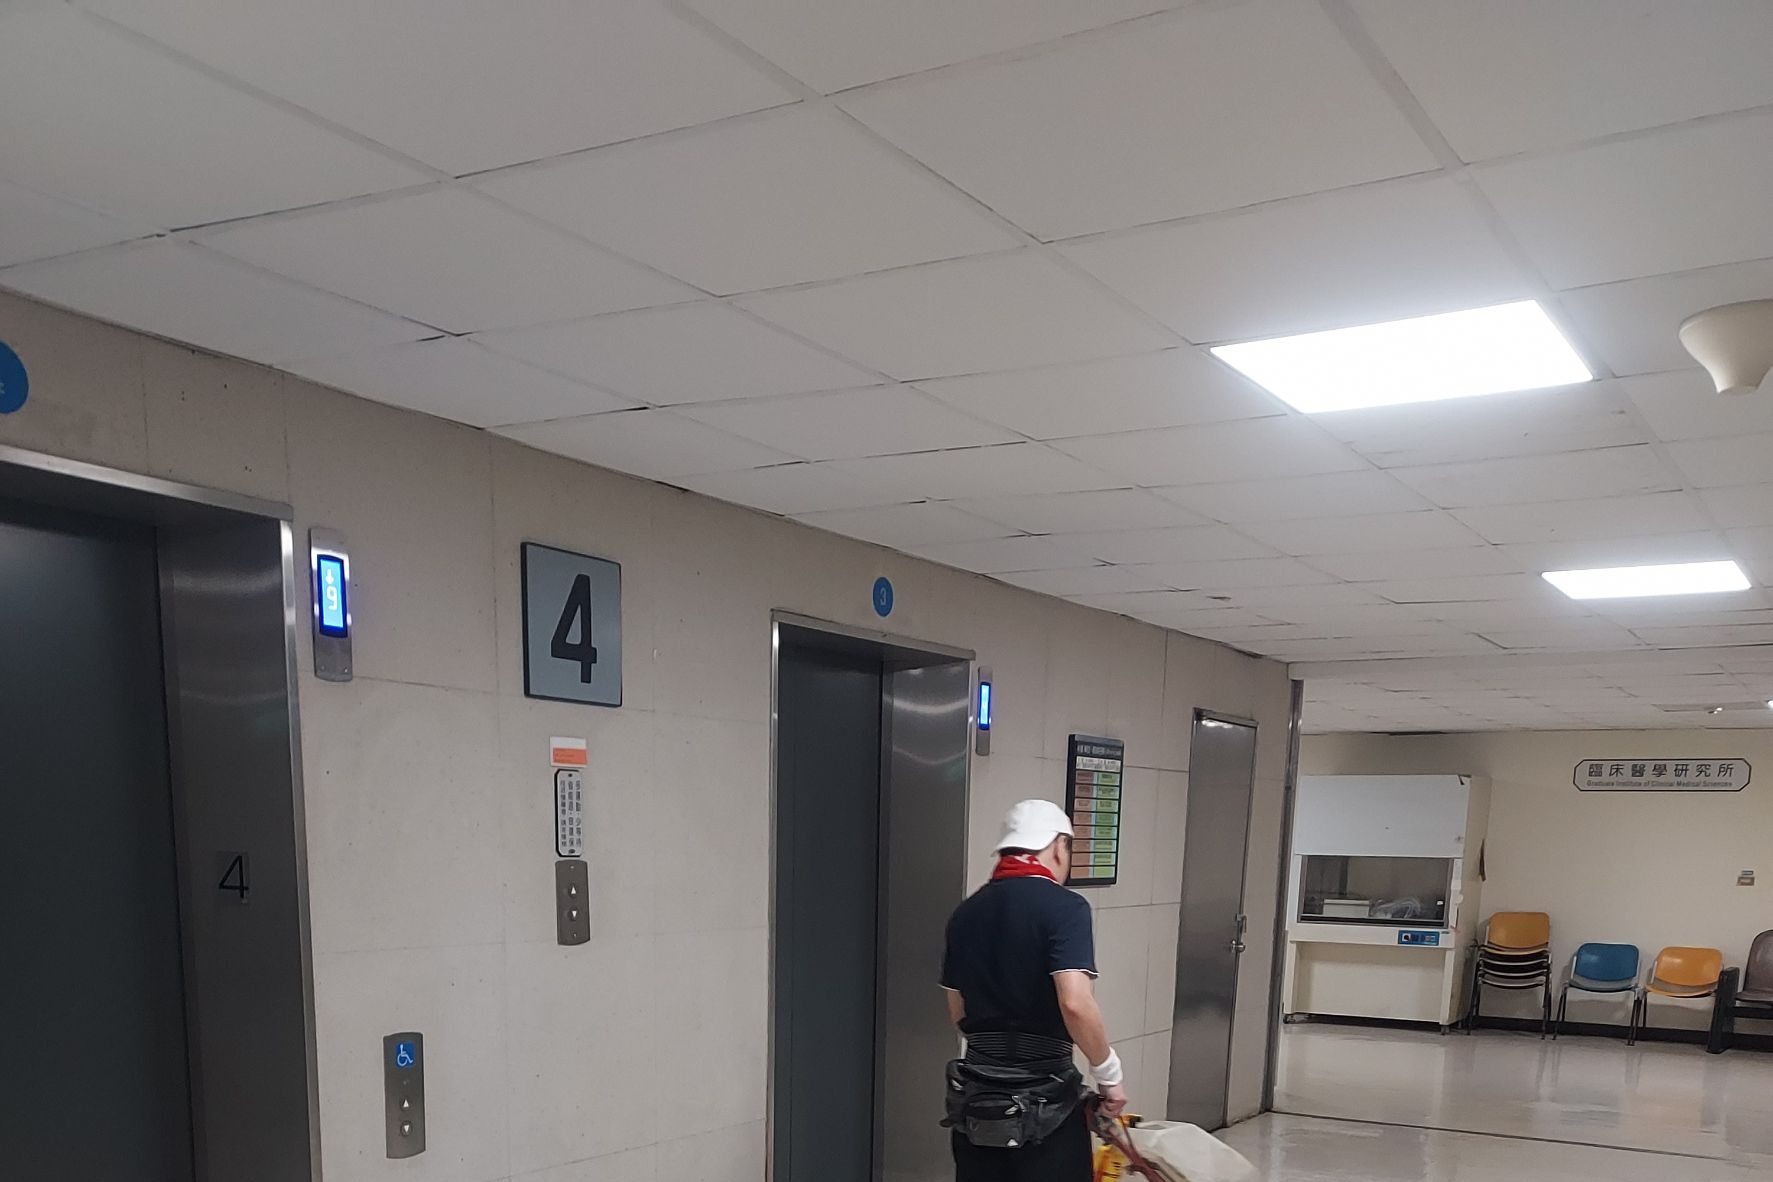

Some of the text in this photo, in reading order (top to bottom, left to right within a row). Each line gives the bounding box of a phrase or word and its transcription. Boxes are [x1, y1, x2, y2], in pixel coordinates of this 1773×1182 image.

[326, 585, 338, 611] 9
[880, 587, 887, 606] 3
[550, 573, 598, 684] 4
[1586, 779, 1615, 787] Graduate
[218, 855, 249, 899] 4
